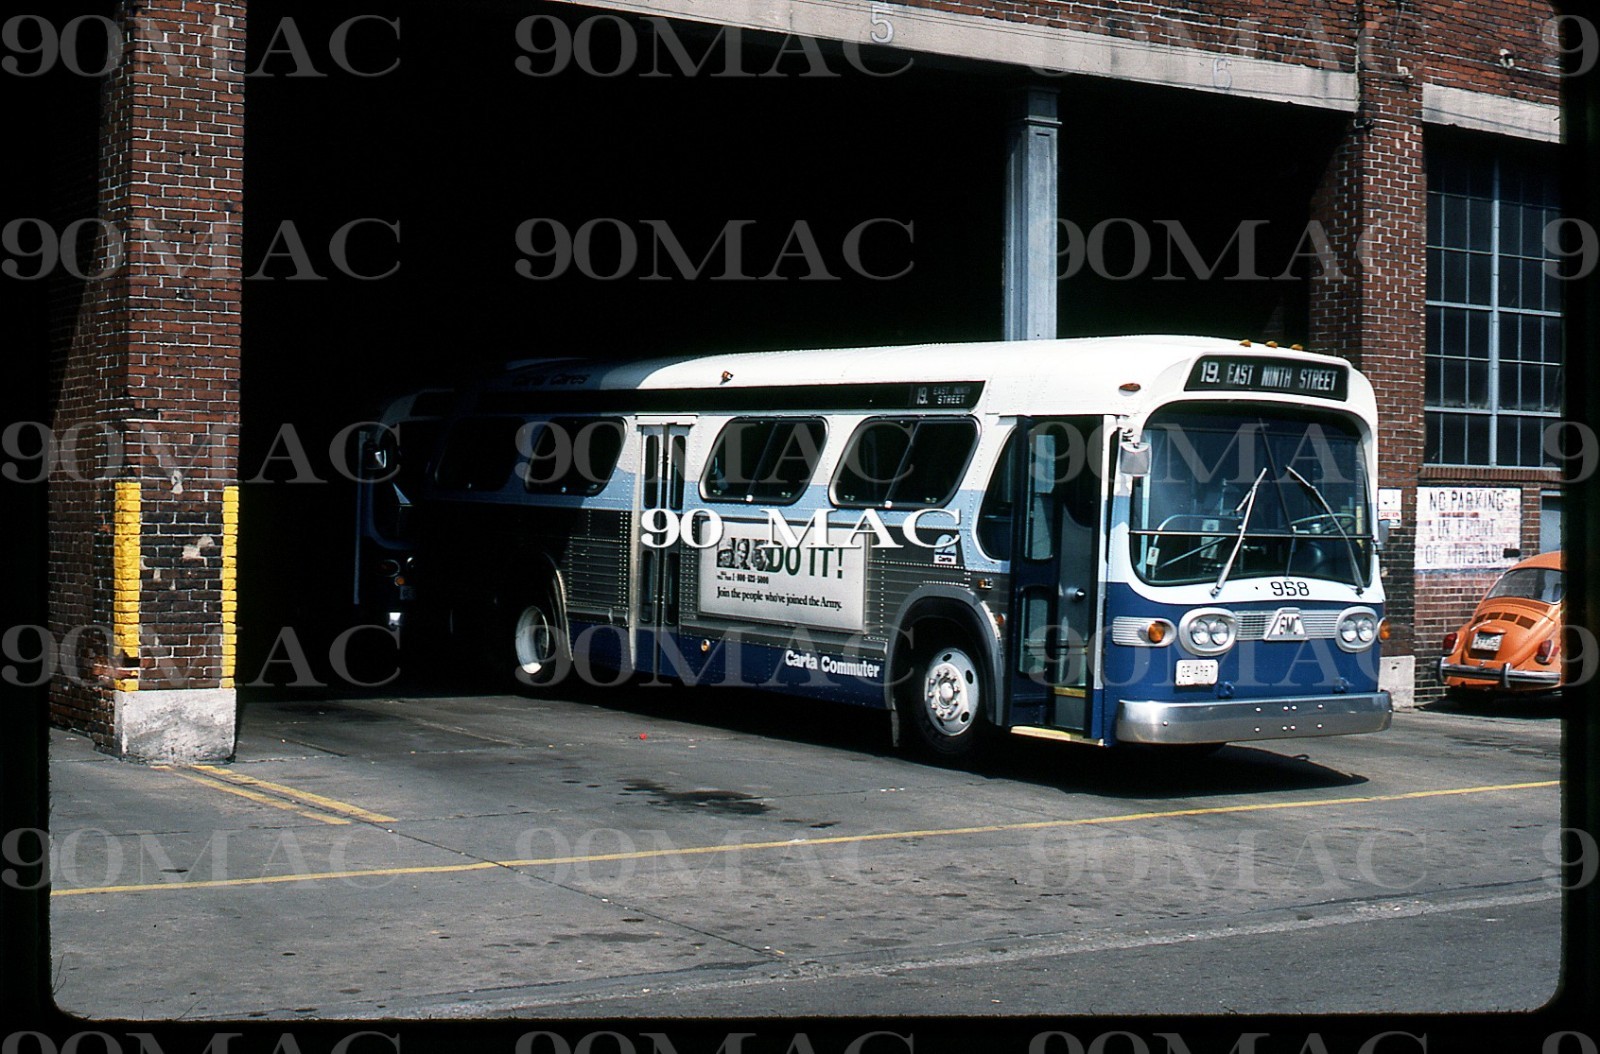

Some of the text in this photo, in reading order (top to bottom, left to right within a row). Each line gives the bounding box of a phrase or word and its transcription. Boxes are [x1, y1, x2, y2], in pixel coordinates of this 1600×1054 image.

[870, 3, 894, 44] 5
[1212, 57, 1232, 90] 6
[1226, 363, 1254, 386] EAST
[1261, 365, 1292, 388] NINTH
[1300, 368, 1338, 391] STREET
[937, 394, 966, 405] STREET
[1429, 490, 1505, 511] NO PARKING
[809, 542, 843, 579] IT!
[717, 587, 729, 598] Join
[731, 588, 740, 598] the
[742, 590, 763, 602] people
[765, 592, 785, 603] who've
[786, 593, 807, 606] joined
[809, 596, 820, 606] the
[1270, 581, 1310, 597] 958
[1279, 616, 1300, 635] GMC
[785, 650, 881, 678] Carta Commuter
